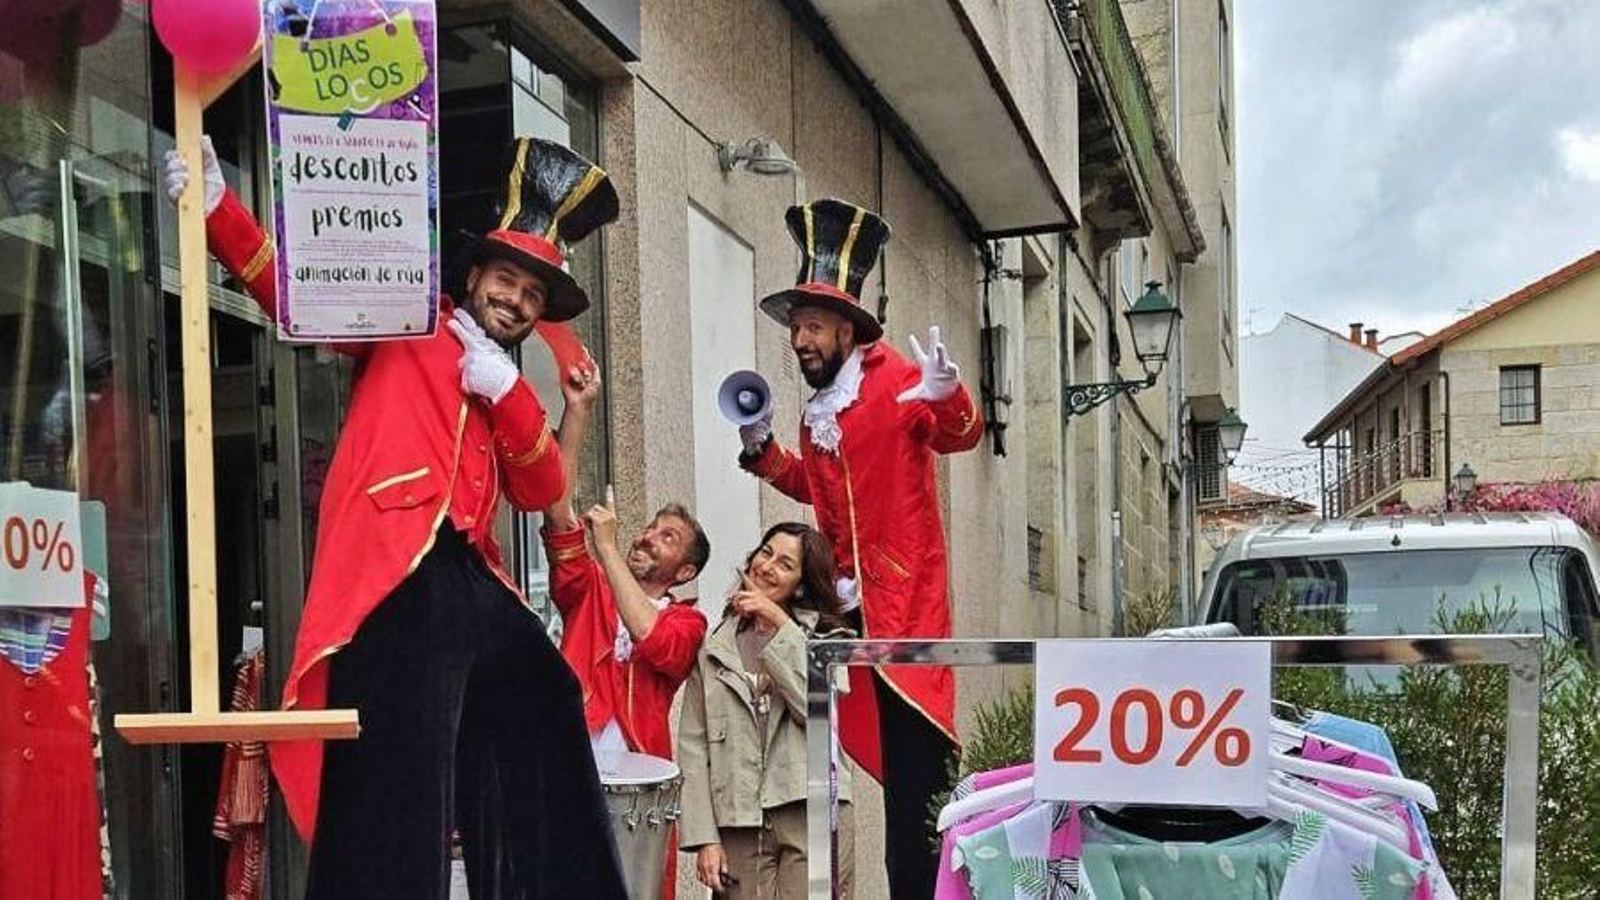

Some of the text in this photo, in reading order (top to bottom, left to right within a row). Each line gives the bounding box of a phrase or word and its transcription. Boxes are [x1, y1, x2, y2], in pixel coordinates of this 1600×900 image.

[308, 39, 370, 73] DÍAS
[315, 62, 404, 102] LOCOS
[290, 152, 418, 186] descontos
[312, 204, 403, 236] premios
[295, 265, 424, 284] animación de rúa
[1053, 688, 1250, 767] 20%
